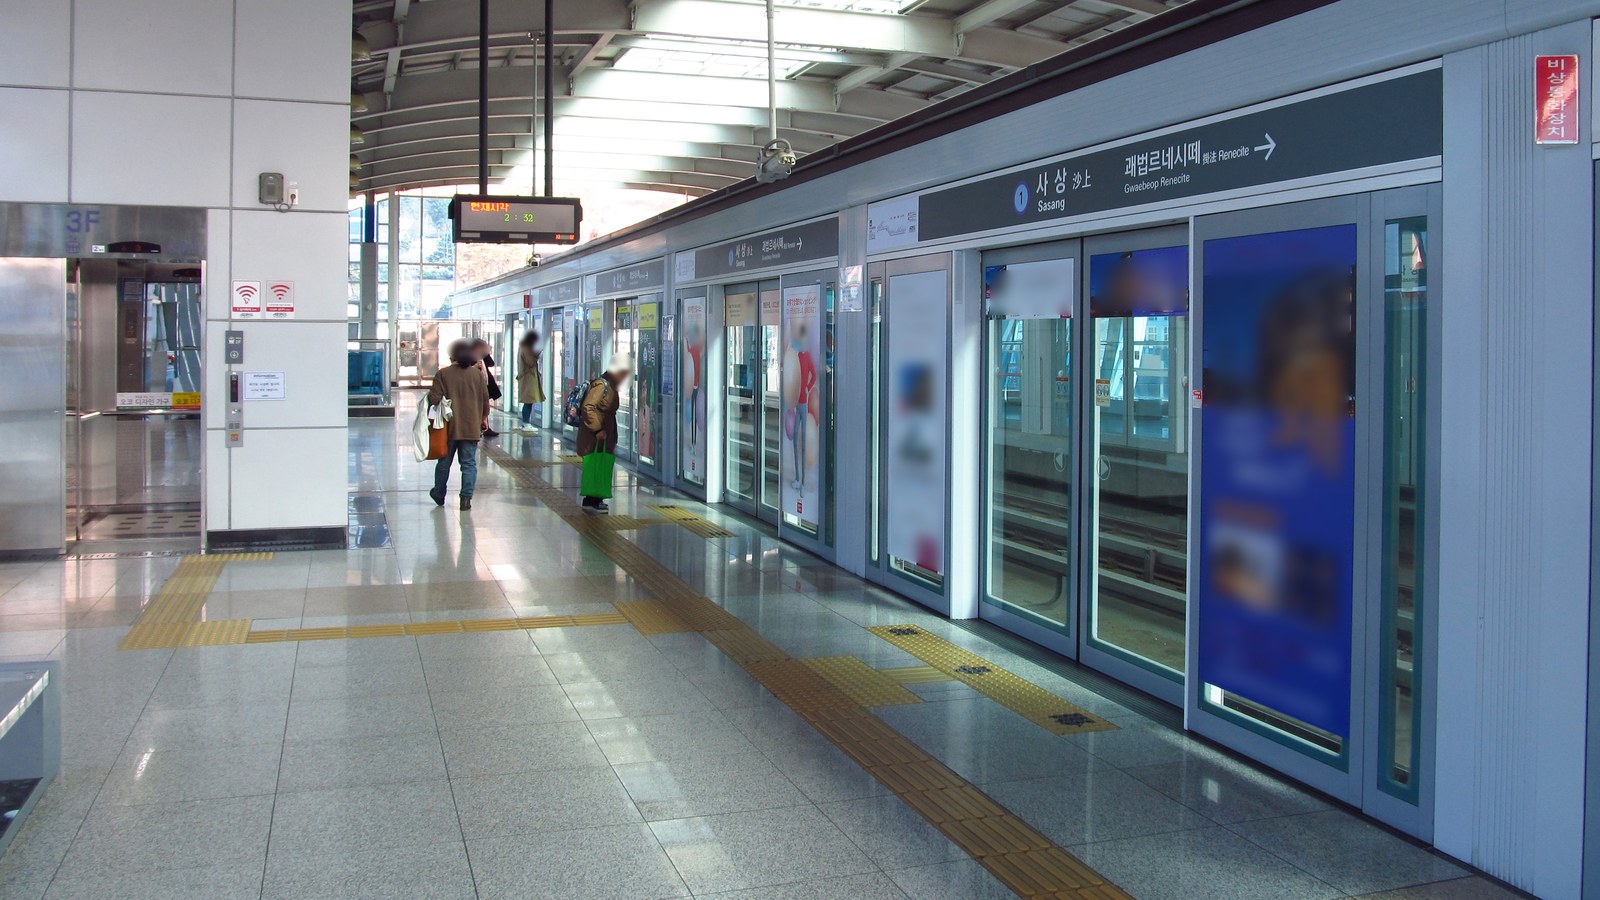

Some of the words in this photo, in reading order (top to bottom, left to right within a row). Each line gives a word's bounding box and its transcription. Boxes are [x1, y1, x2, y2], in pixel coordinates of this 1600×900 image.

[1547, 59, 1567, 138] 비상통화장치
[1072, 169, 1092, 190] 沙上
[1124, 140, 1201, 177] 괘법르네시떼
[1218, 145, 1250, 161] Renecite
[1124, 180, 1159, 194] Gwaebeop
[1160, 173, 1191, 187] Renecite
[470, 202, 509, 212] 현재시각
[1038, 198, 1066, 213] Sasang
[66, 210, 99, 232] 3F
